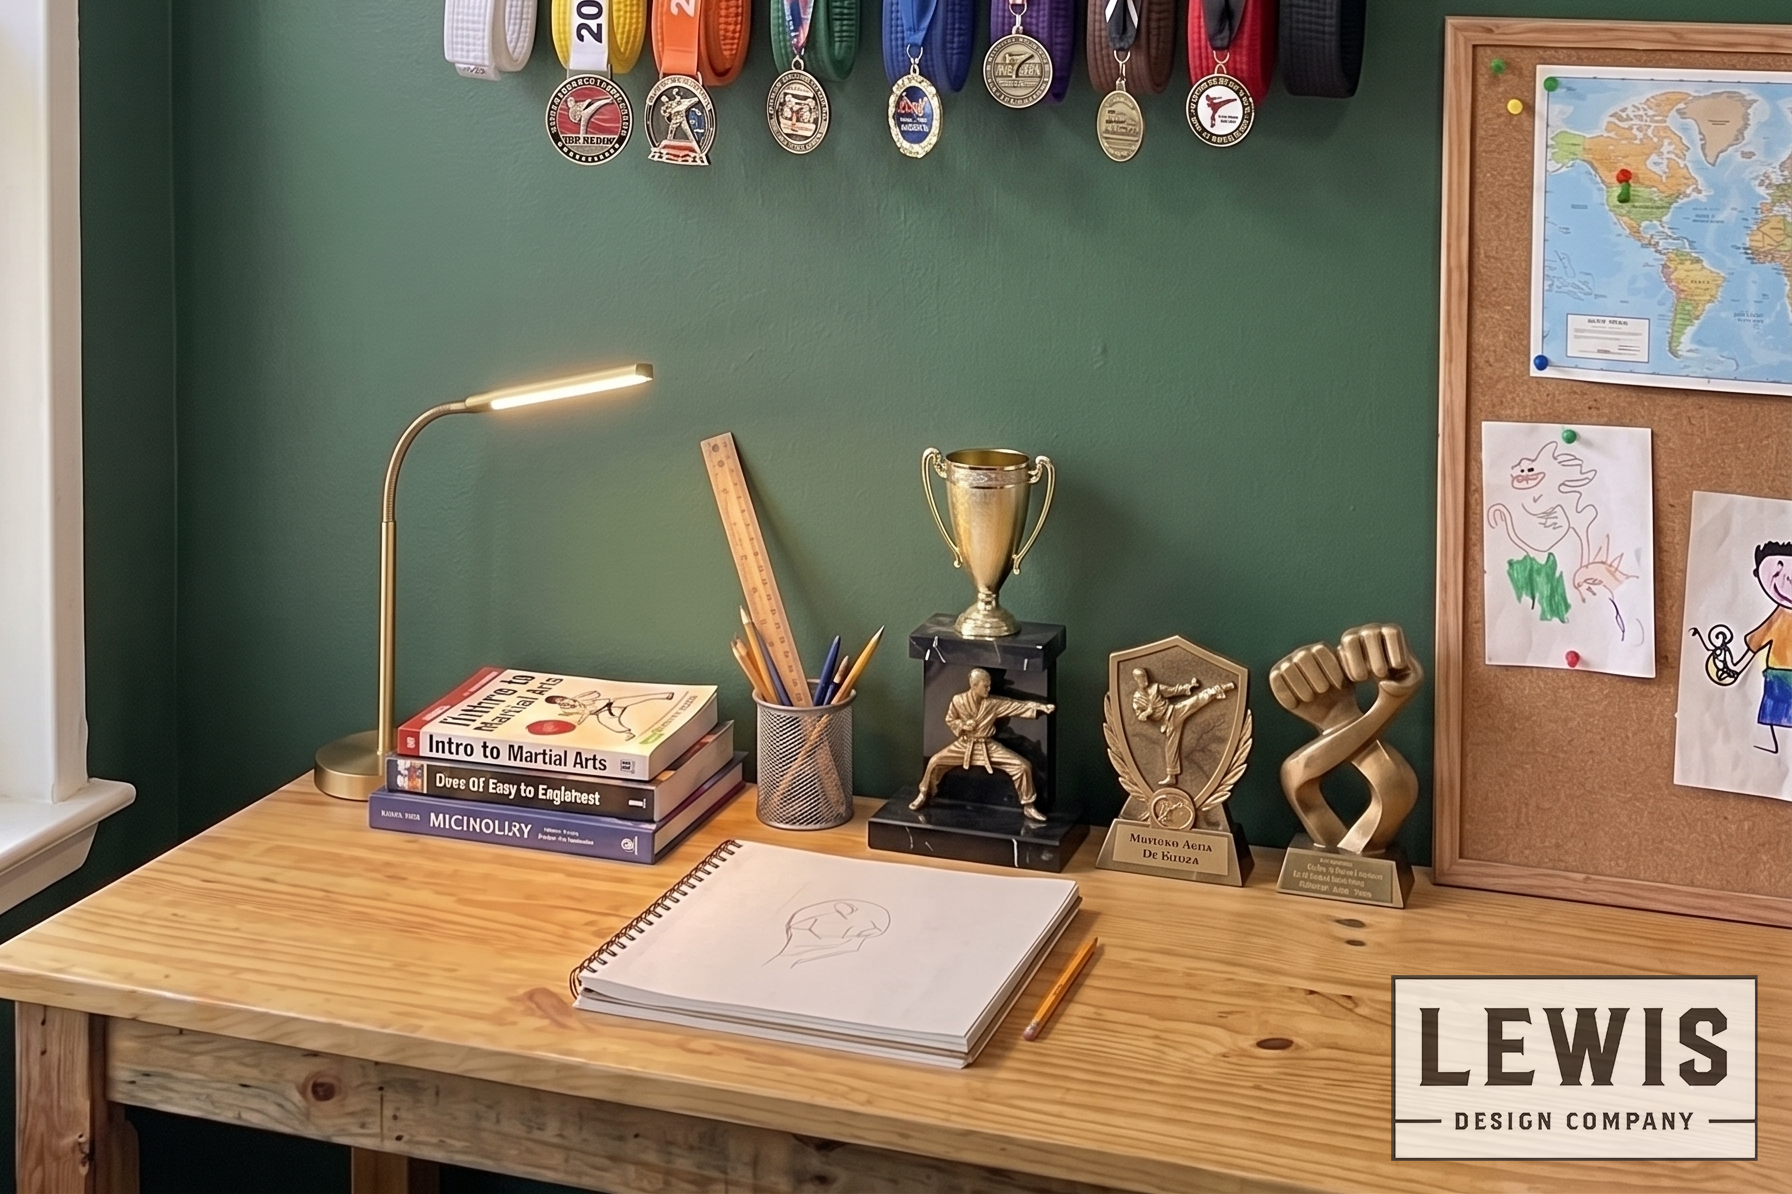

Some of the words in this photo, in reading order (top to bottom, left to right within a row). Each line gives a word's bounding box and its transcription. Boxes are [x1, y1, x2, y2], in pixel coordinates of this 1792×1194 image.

[428, 734, 475, 757] Intro
[481, 738, 501, 761] to
[507, 744, 568, 768] Martial
[573, 750, 608, 772] Arts
[488, 779, 517, 800] Easy
[520, 782, 535, 798] to
